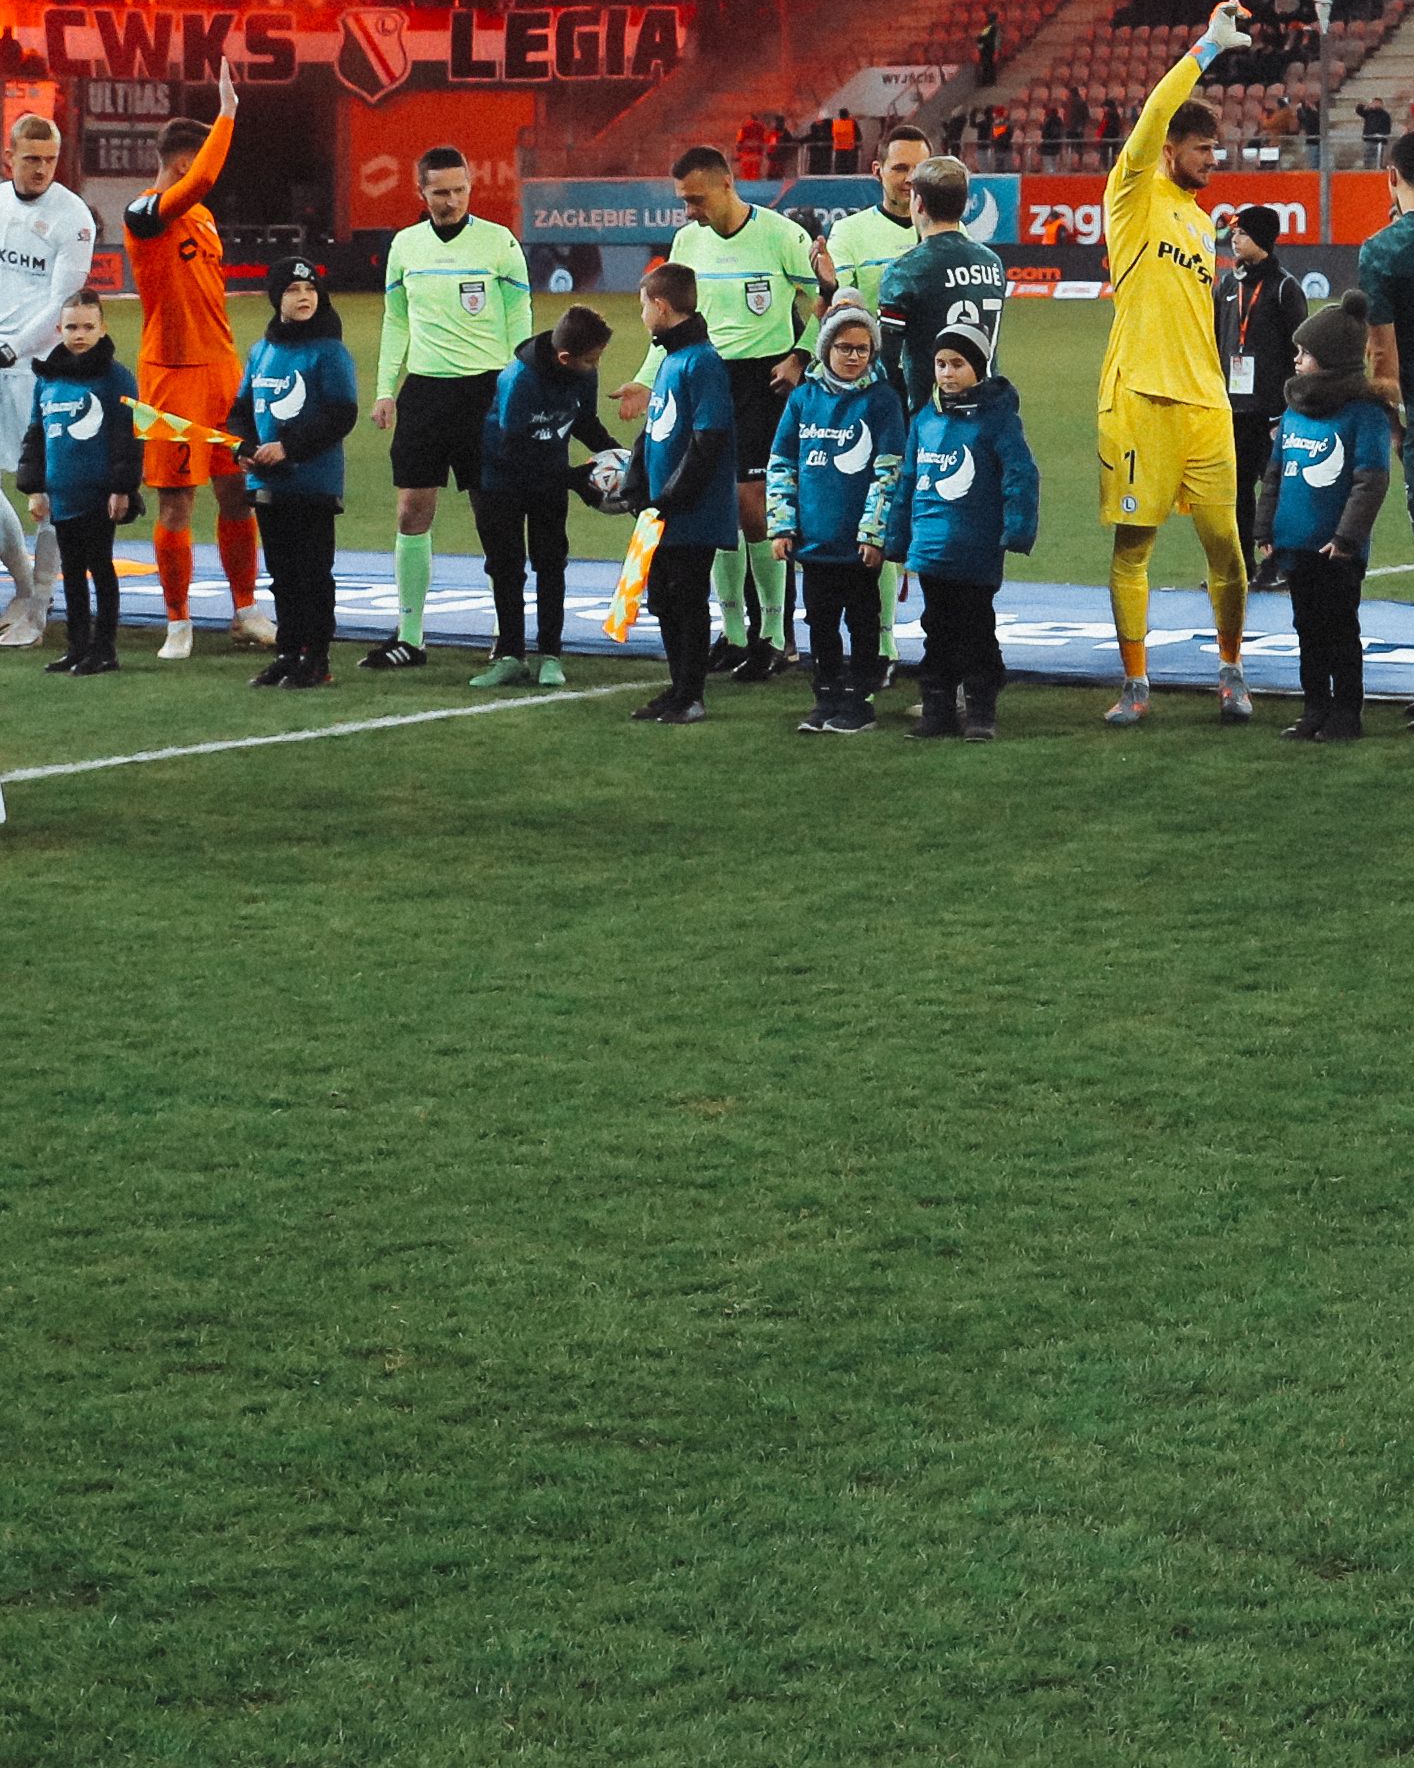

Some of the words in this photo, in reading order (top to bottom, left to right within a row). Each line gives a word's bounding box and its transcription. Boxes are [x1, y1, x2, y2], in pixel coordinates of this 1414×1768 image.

[43, 6, 299, 83] CWKS
[448, 5, 684, 82] LEGIA
[644, 208, 693, 229] LUB
[944, 262, 1002, 288] JOSUÉ
[1124, 449, 1136, 485] 1
